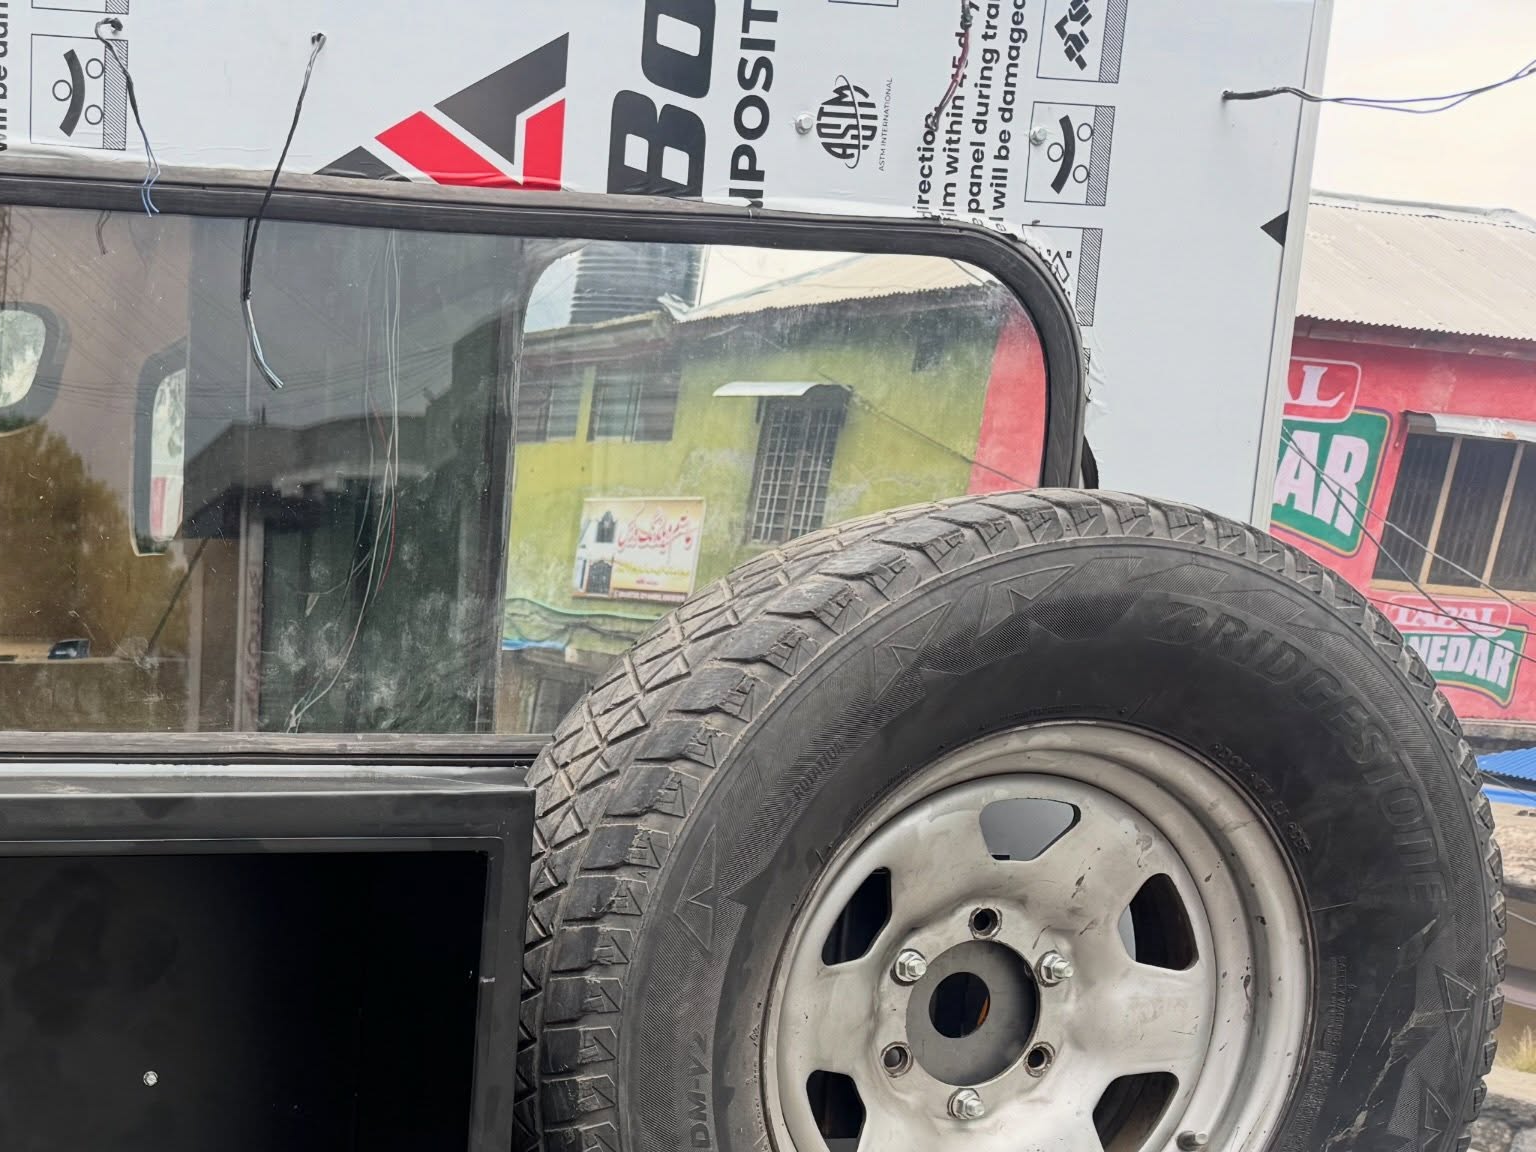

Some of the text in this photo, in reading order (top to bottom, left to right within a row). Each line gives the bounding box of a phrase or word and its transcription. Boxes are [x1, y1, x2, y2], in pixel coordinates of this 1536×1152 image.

[981, 0, 1001, 42] tra
[816, 84, 878, 160] ASTM
[878, 77, 893, 172] ASTM INTERNATIONAL
[971, 47, 1001, 134] during
[942, 95, 965, 175] within
[993, 129, 1012, 161] be
[968, 141, 986, 214] panel
[989, 167, 1009, 210] will
[1392, 604, 1502, 633] TAPAL
[1156, 600, 1450, 908] BRIDGESTONE
[686, 1029, 712, 1149] DM-V2
